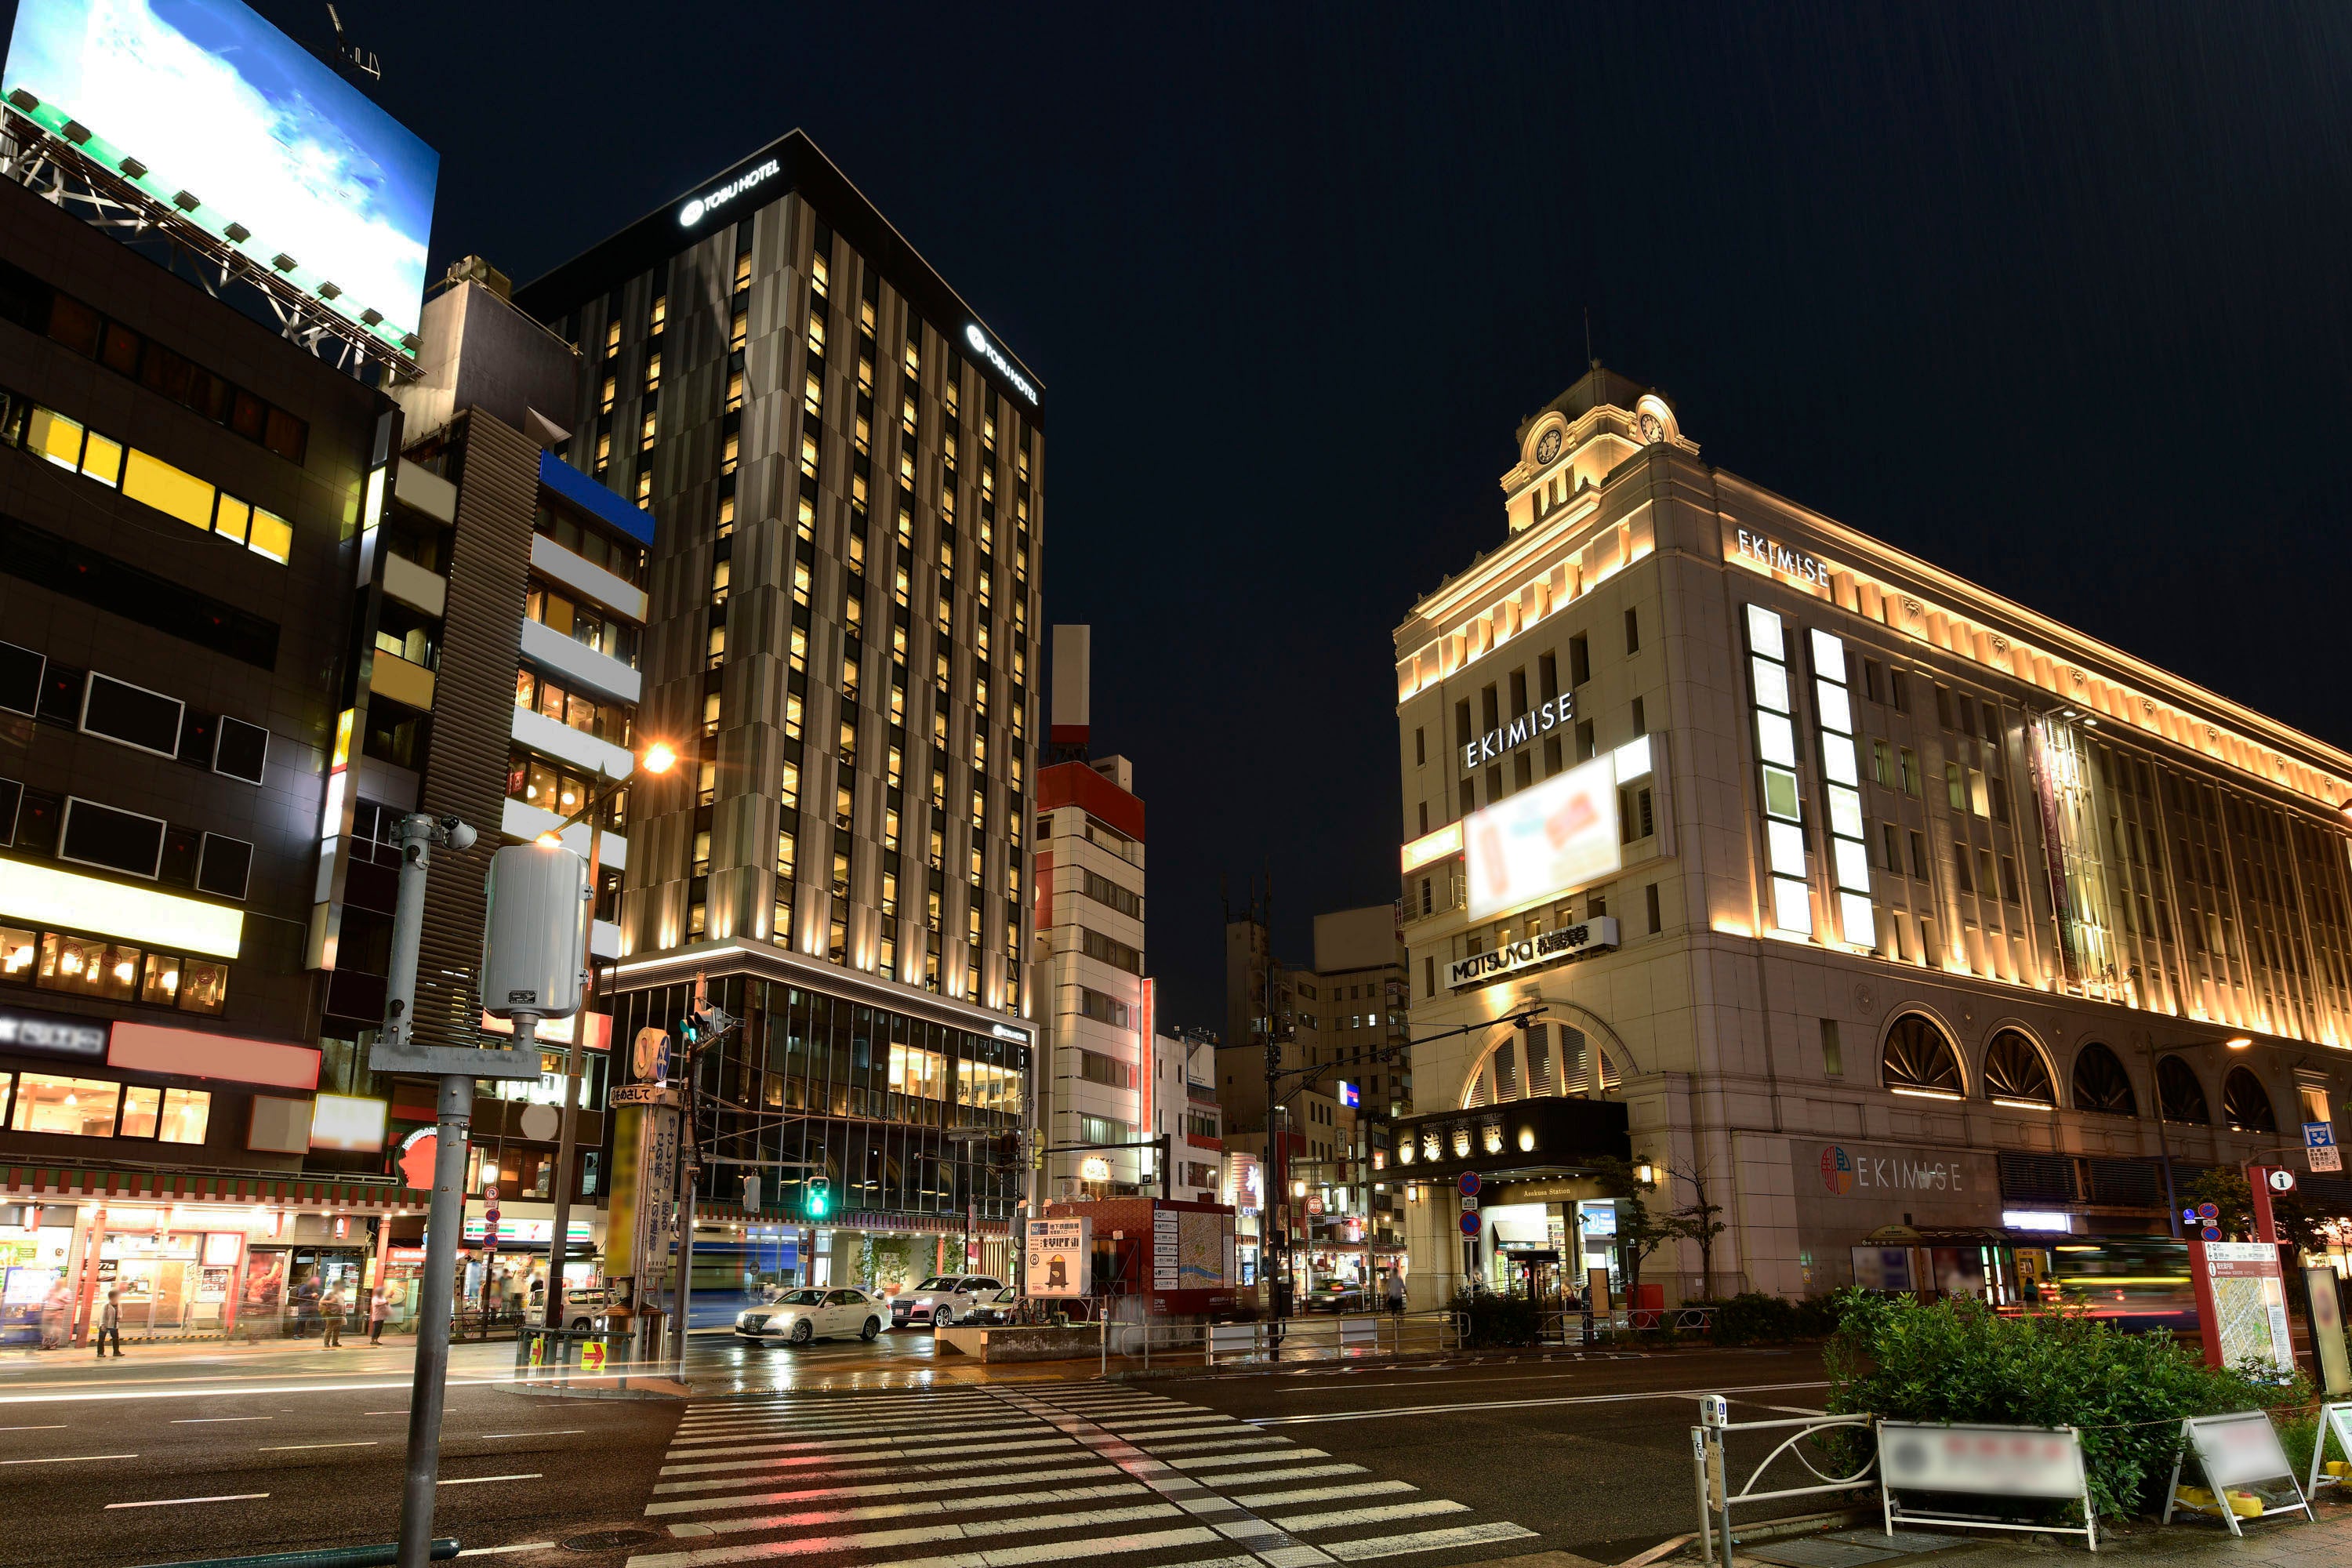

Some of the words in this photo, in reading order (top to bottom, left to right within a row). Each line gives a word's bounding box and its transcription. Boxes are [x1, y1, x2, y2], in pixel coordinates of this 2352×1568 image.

[704, 181, 738, 211] TOBU
[739, 159, 780, 192] HOTEL
[985, 343, 1011, 376] TOBU
[1011, 368, 1038, 406] HOTEL
[1737, 528, 1829, 588] EKIMISE
[1467, 692, 1573, 769] EKIMISE
[401, 1127, 437, 1151] ICHIRAN
[655, 1132, 664, 1178] この街
[662, 1116, 676, 1189] やさしさが
[1422, 1125, 1503, 1160] 浅草駅
[1548, 1187, 1570, 1196] Station
[1857, 1157, 1962, 1191] EKIMISE
[661, 1200, 670, 1231] 走る
